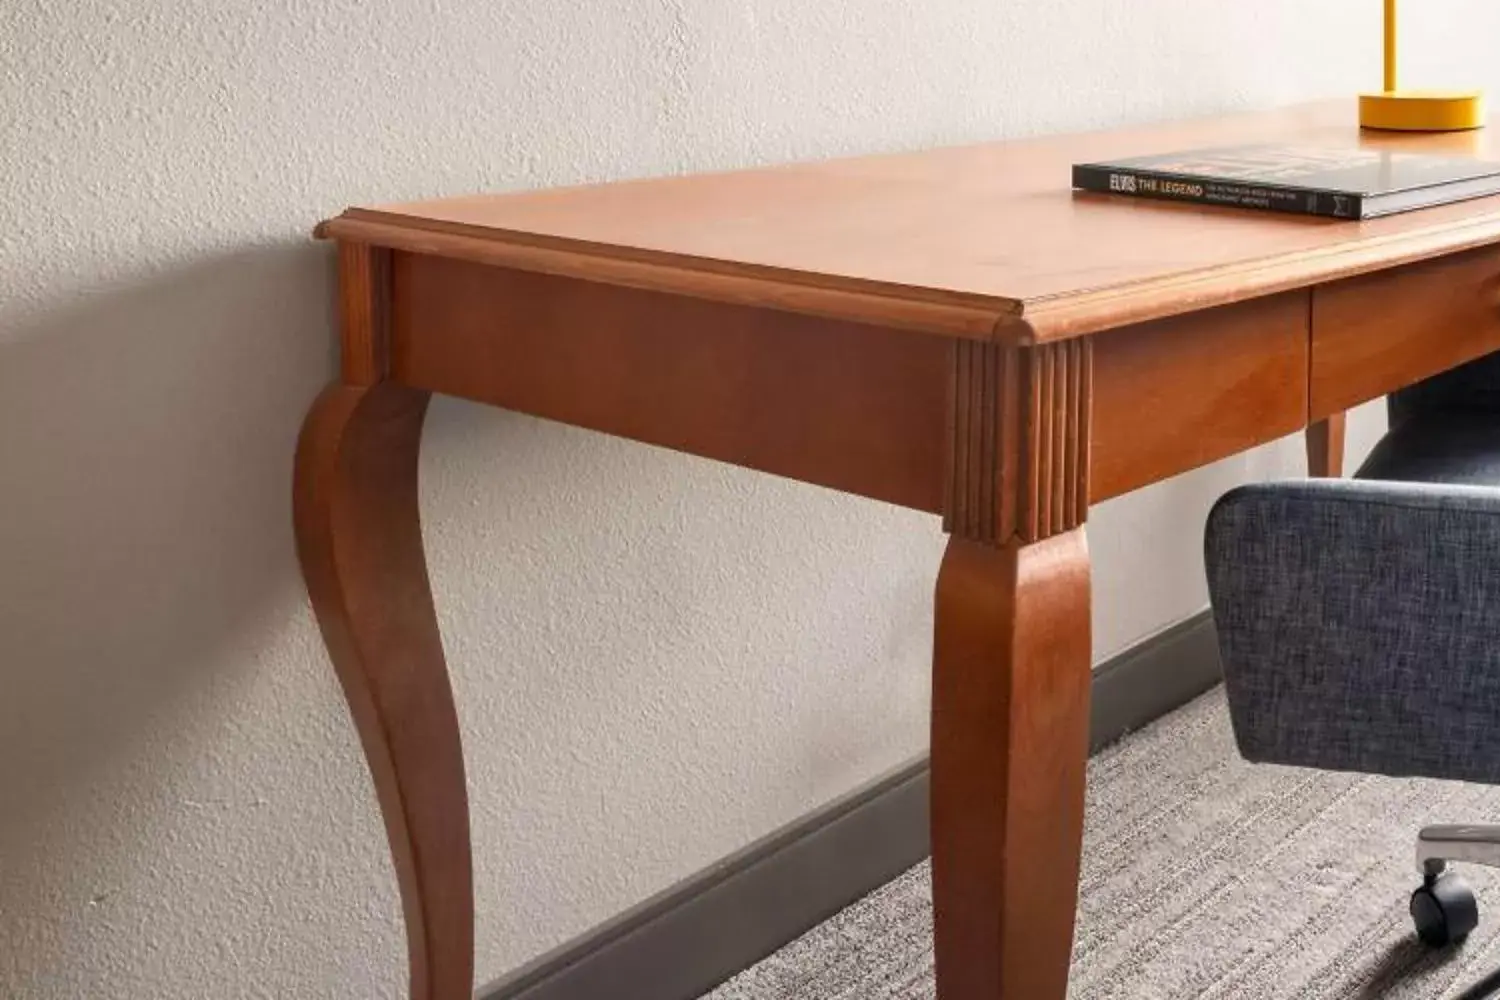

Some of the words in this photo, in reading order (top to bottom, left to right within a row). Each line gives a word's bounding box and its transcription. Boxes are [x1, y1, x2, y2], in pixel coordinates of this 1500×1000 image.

[1109, 173, 1136, 192] ELVIS
[1138, 178, 1157, 191] THE
[1161, 181, 1203, 196] LEGEND
